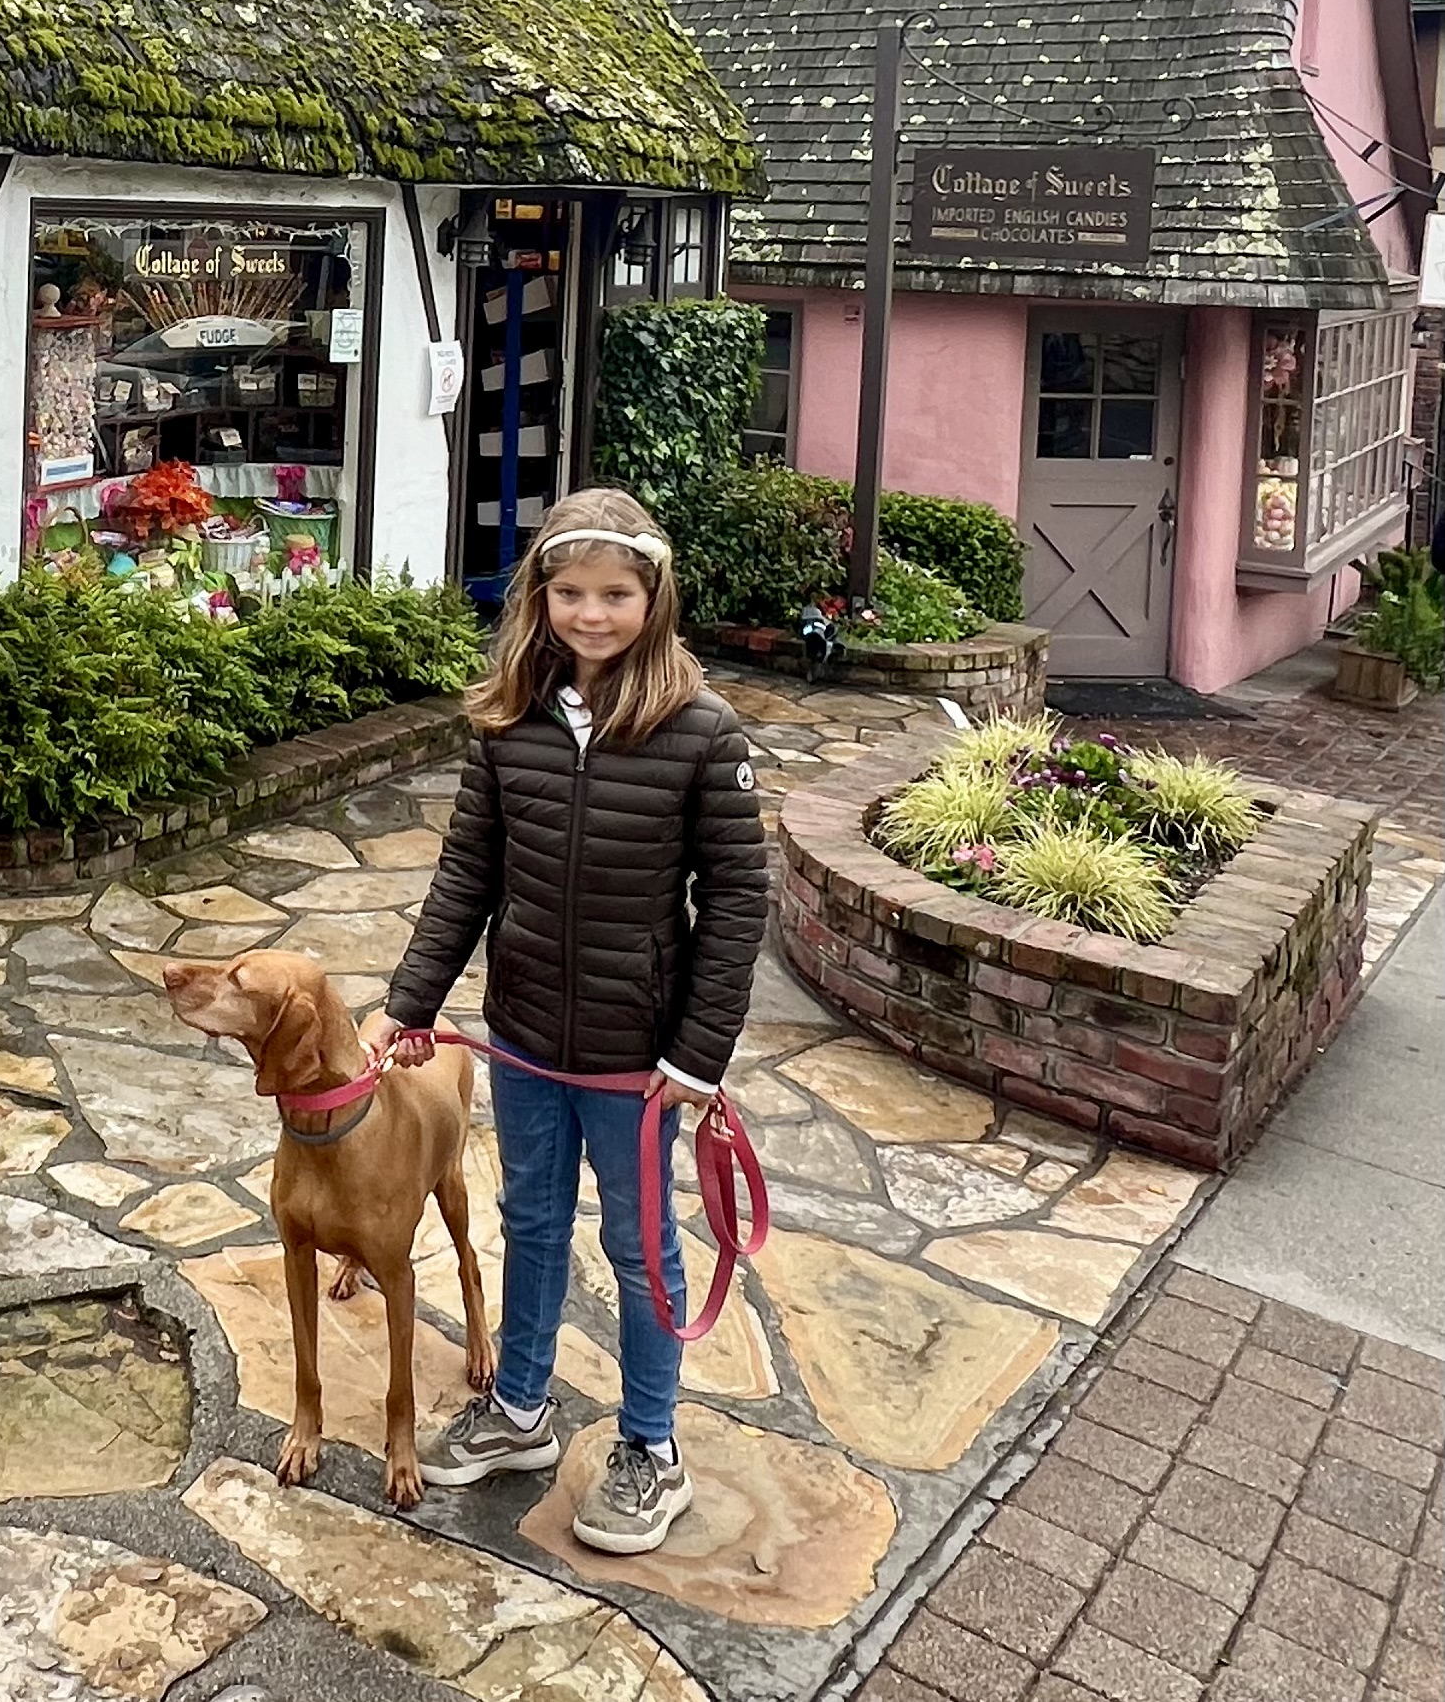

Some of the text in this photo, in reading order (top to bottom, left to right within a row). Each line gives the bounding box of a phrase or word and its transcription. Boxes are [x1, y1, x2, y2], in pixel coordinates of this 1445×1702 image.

[932, 163, 1132, 203] Cottage of Sweets
[931, 206, 1129, 228] IMPORTED ENGLISH CANDIES
[981, 226, 1075, 245] CHOCOLATES
[135, 244, 287, 279] Cottage of Sweets
[199, 328, 237, 344] FUDGE
